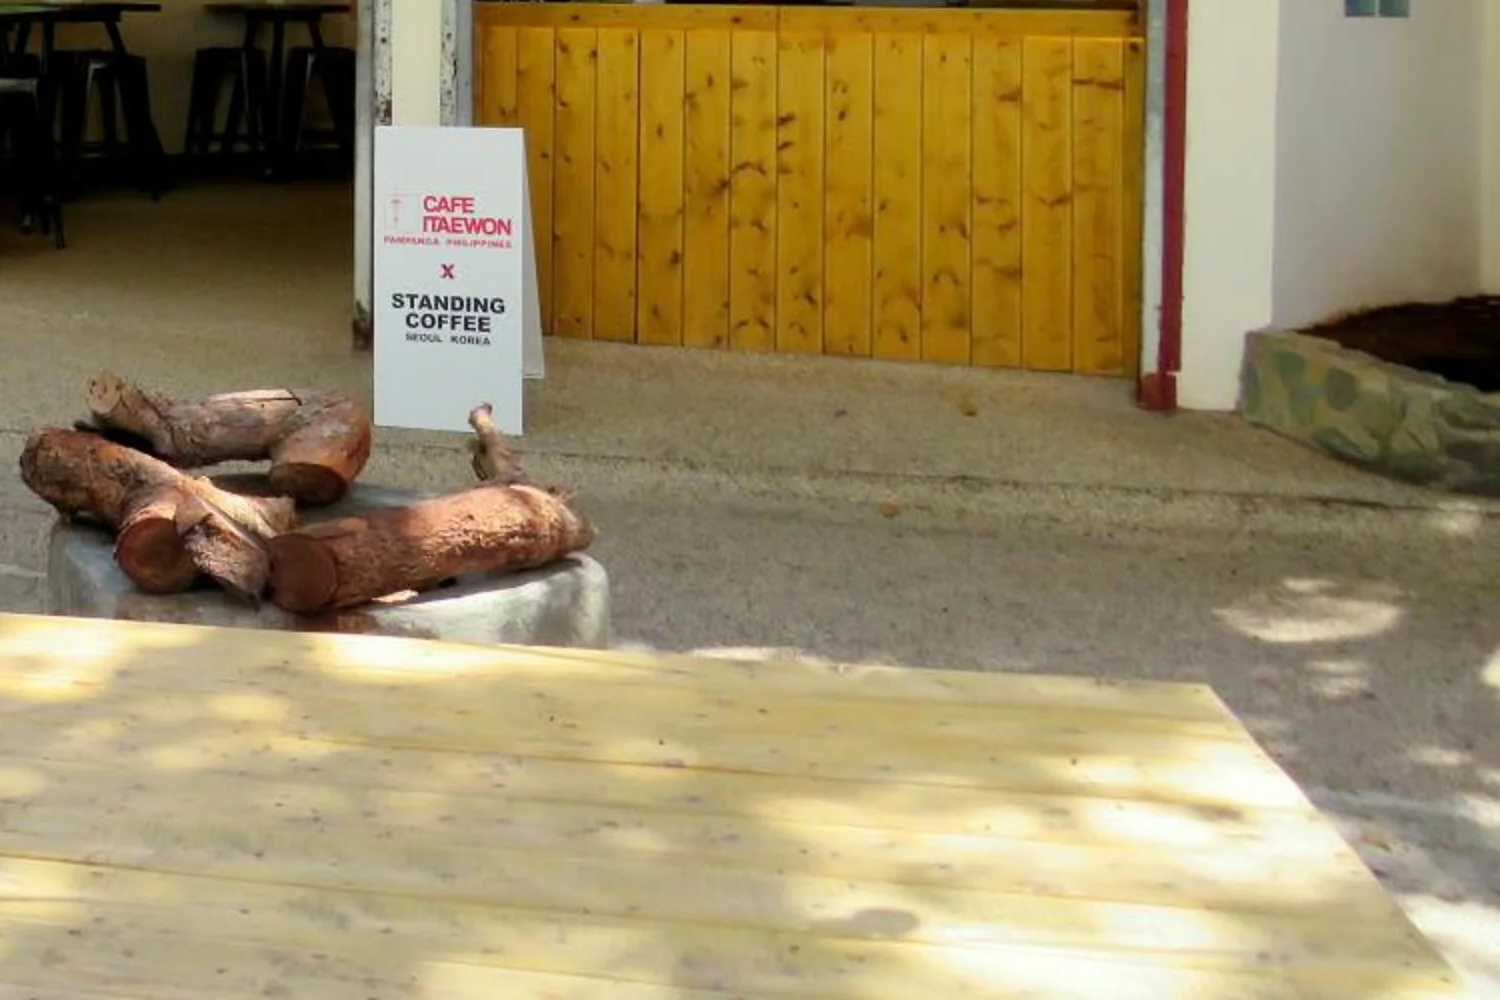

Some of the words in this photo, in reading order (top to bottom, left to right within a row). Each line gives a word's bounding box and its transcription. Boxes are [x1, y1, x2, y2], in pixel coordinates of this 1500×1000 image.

[423, 195, 475, 214] CAFE
[422, 215, 512, 236] ITAEWON
[384, 236, 440, 246] PAMPANGA
[446, 239, 513, 249] PHILIPPINES
[391, 293, 505, 315] STANDING
[405, 312, 491, 333] COFFEE
[405, 332, 443, 343] SEOUL
[449, 335, 491, 346] KOREA
